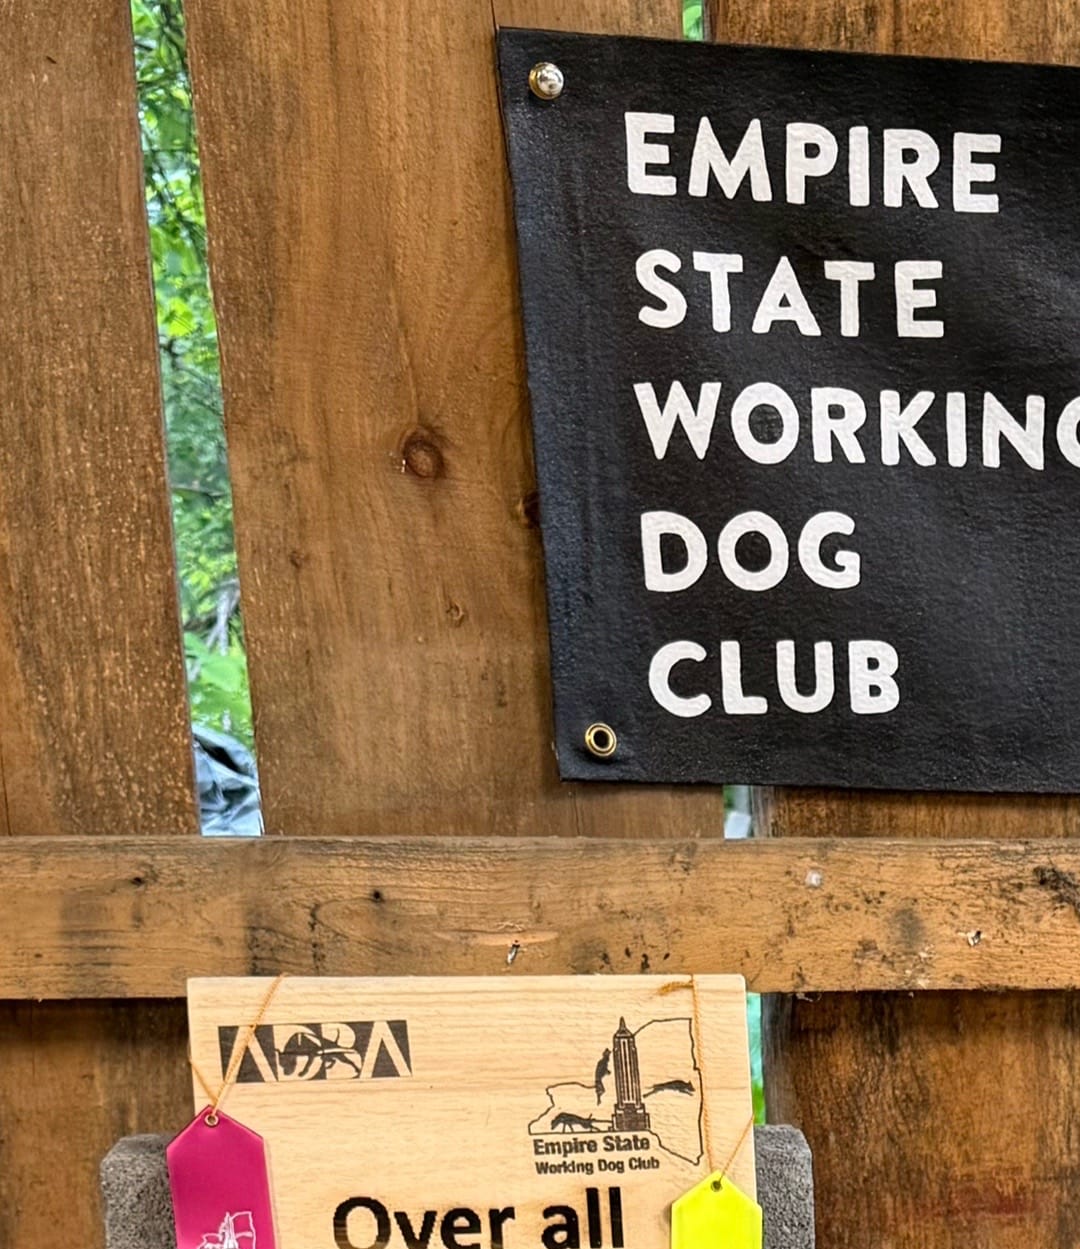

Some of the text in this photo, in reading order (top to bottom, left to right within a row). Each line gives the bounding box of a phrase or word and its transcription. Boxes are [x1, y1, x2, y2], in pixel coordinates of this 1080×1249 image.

[625, 111, 1002, 214] EMPIRE
[634, 248, 945, 338] STATE
[640, 510, 861, 592] DOG
[648, 639, 901, 718] CLUB
[533, 1134, 651, 1157] Empire State
[535, 1156, 660, 1175] Working Dog Club
